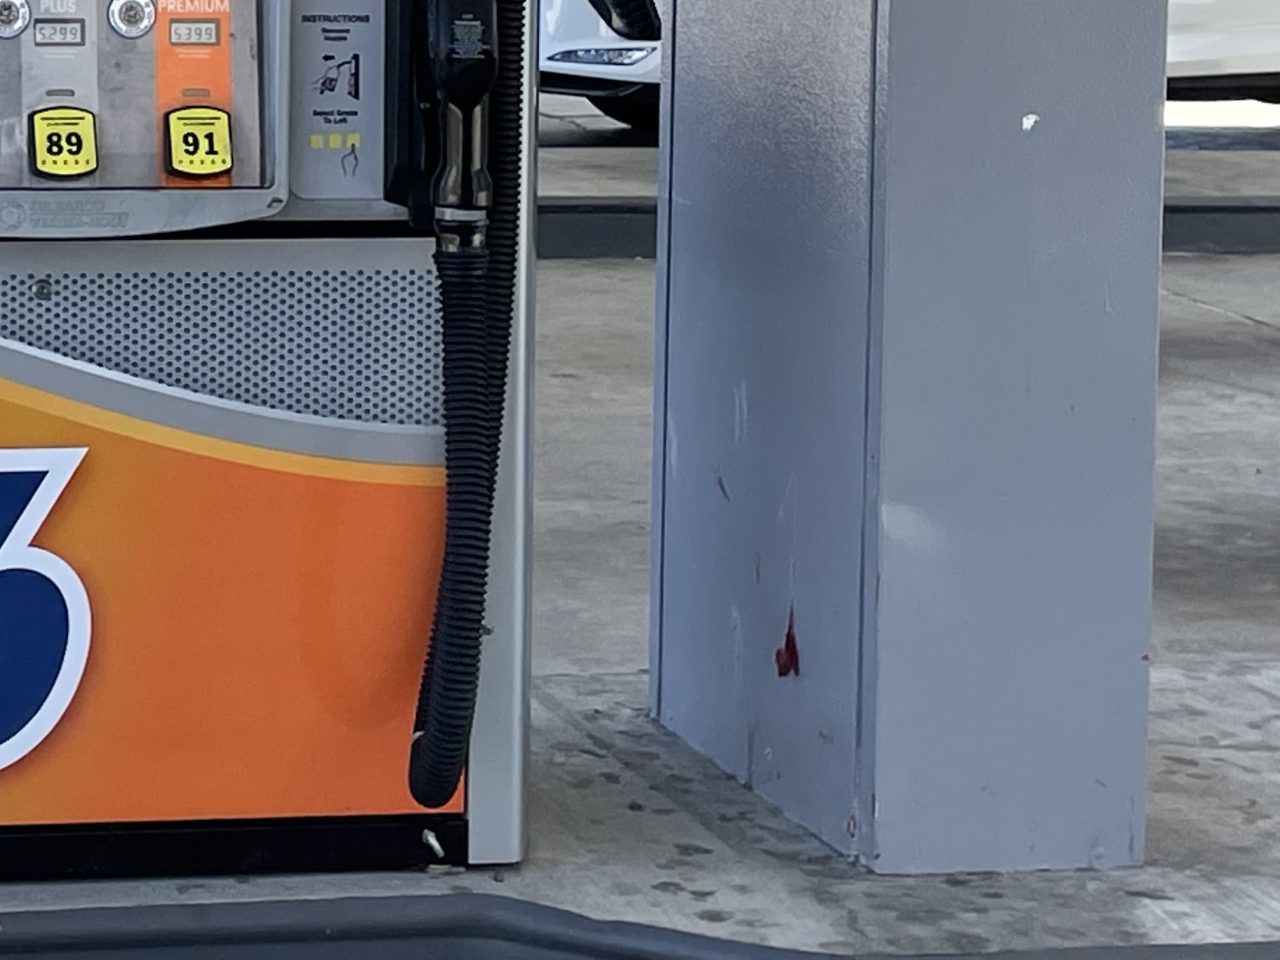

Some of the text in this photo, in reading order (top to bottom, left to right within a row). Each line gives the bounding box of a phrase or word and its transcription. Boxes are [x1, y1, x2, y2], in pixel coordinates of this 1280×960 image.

[301, 14, 370, 23] INSTRUCTIONS
[46, 132, 83, 156] 89
[182, 131, 219, 156] 91
